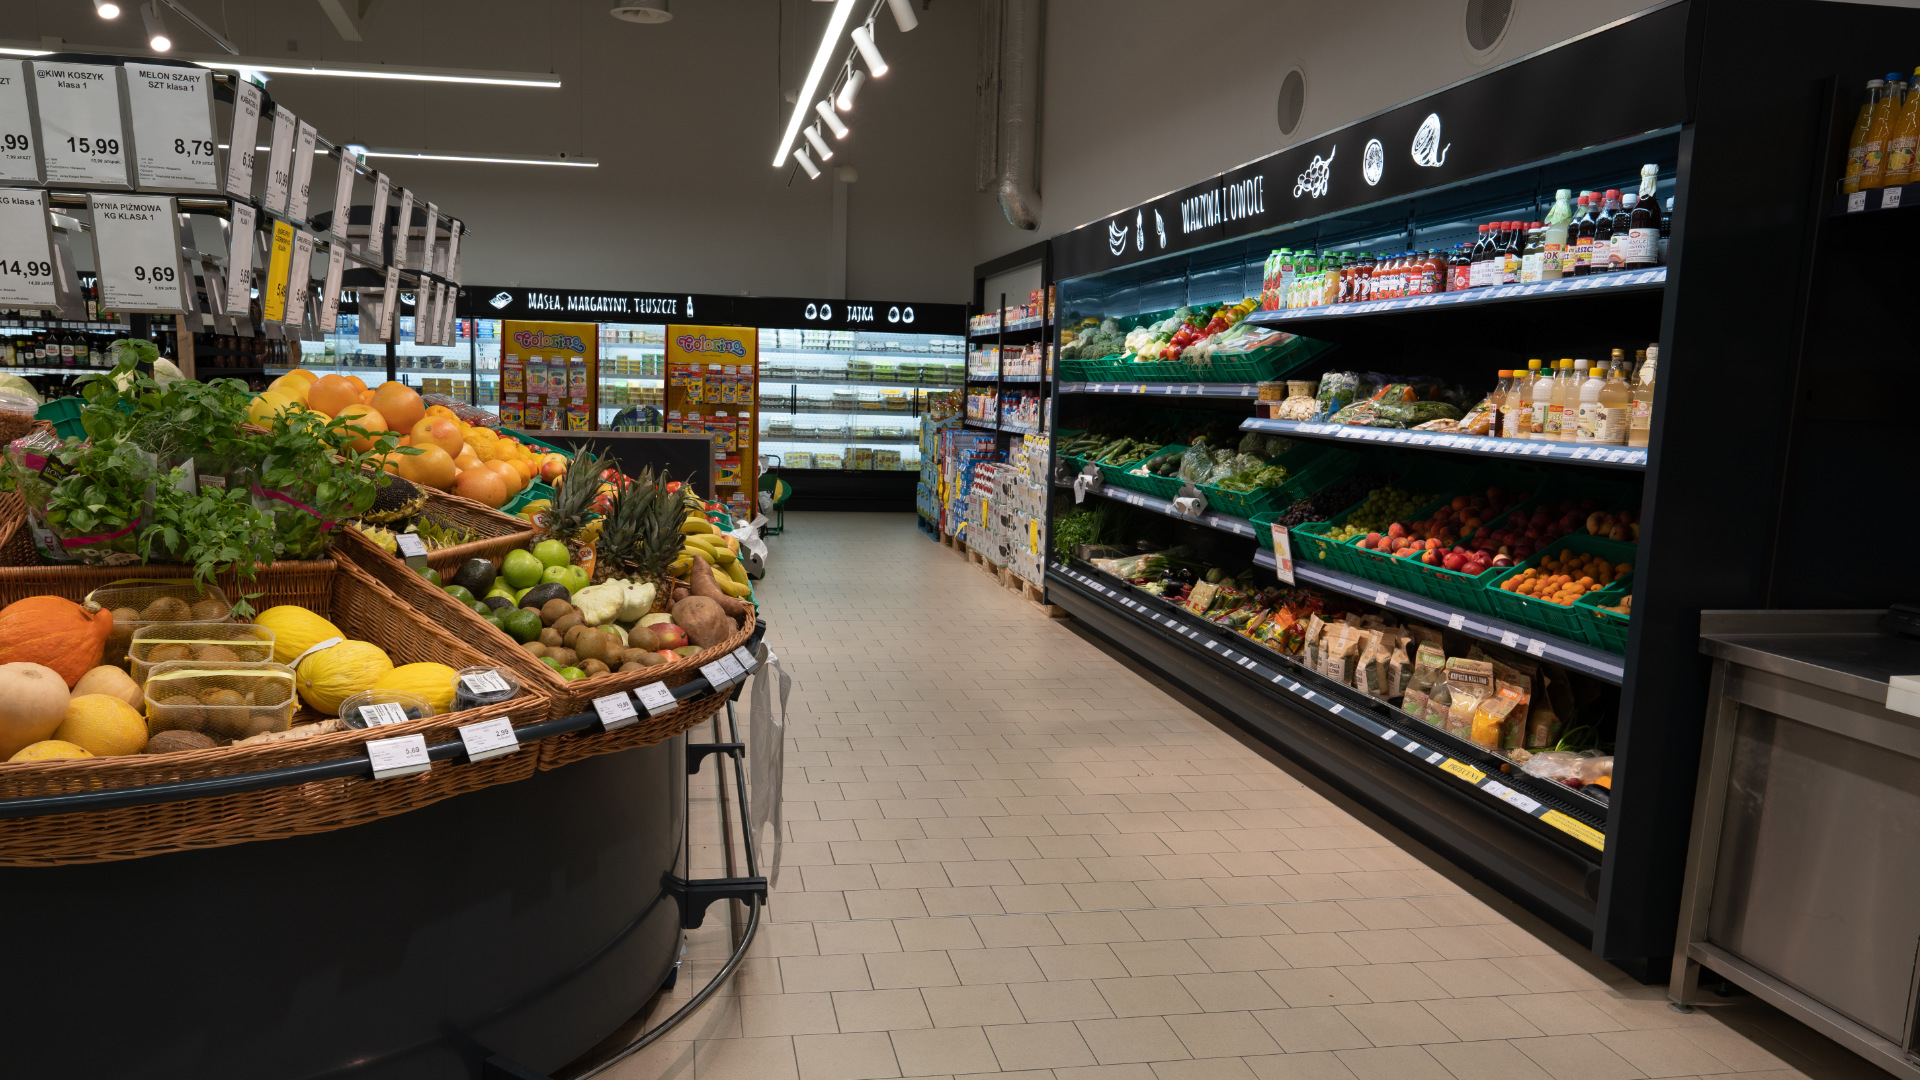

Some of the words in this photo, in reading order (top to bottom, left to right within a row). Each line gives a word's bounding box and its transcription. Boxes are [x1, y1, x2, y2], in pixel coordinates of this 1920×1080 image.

[37, 69, 65, 79] @KIWI
[67, 71, 104, 81] KOSZYK
[139, 70, 170, 79] MELON
[172, 74, 201, 83] SZARY
[58, 81, 80, 89] klasa
[148, 81, 164, 89] SZT
[166, 83, 188, 91] klasa
[66, 136, 119, 156] 15,99
[174, 138, 214, 157] 8,79
[12, 198, 35, 206] klasa
[93, 202, 118, 211] DYNIA
[120, 203, 161, 212] PIŻMOWA
[1182, 189, 1221, 234] WARZYWA
[1223, 187, 1228, 222] I
[1230, 175, 1265, 221] OWOCE
[118, 213, 148, 221] KLASA
[0, 260, 51, 278] 14,99
[134, 265, 174, 284] 9,69
[528, 292, 564, 311] MASŁA,
[567, 295, 631, 314] MARGARYNY,
[633, 298, 677, 314] TŁUSZCZE
[847, 305, 874, 322] JAJKA
[514, 330, 586, 354] Colorino
[677, 334, 746, 357] Colorino
[496, 728, 509, 737] 2,99
[1448, 762, 1479, 782] PRZECENA
